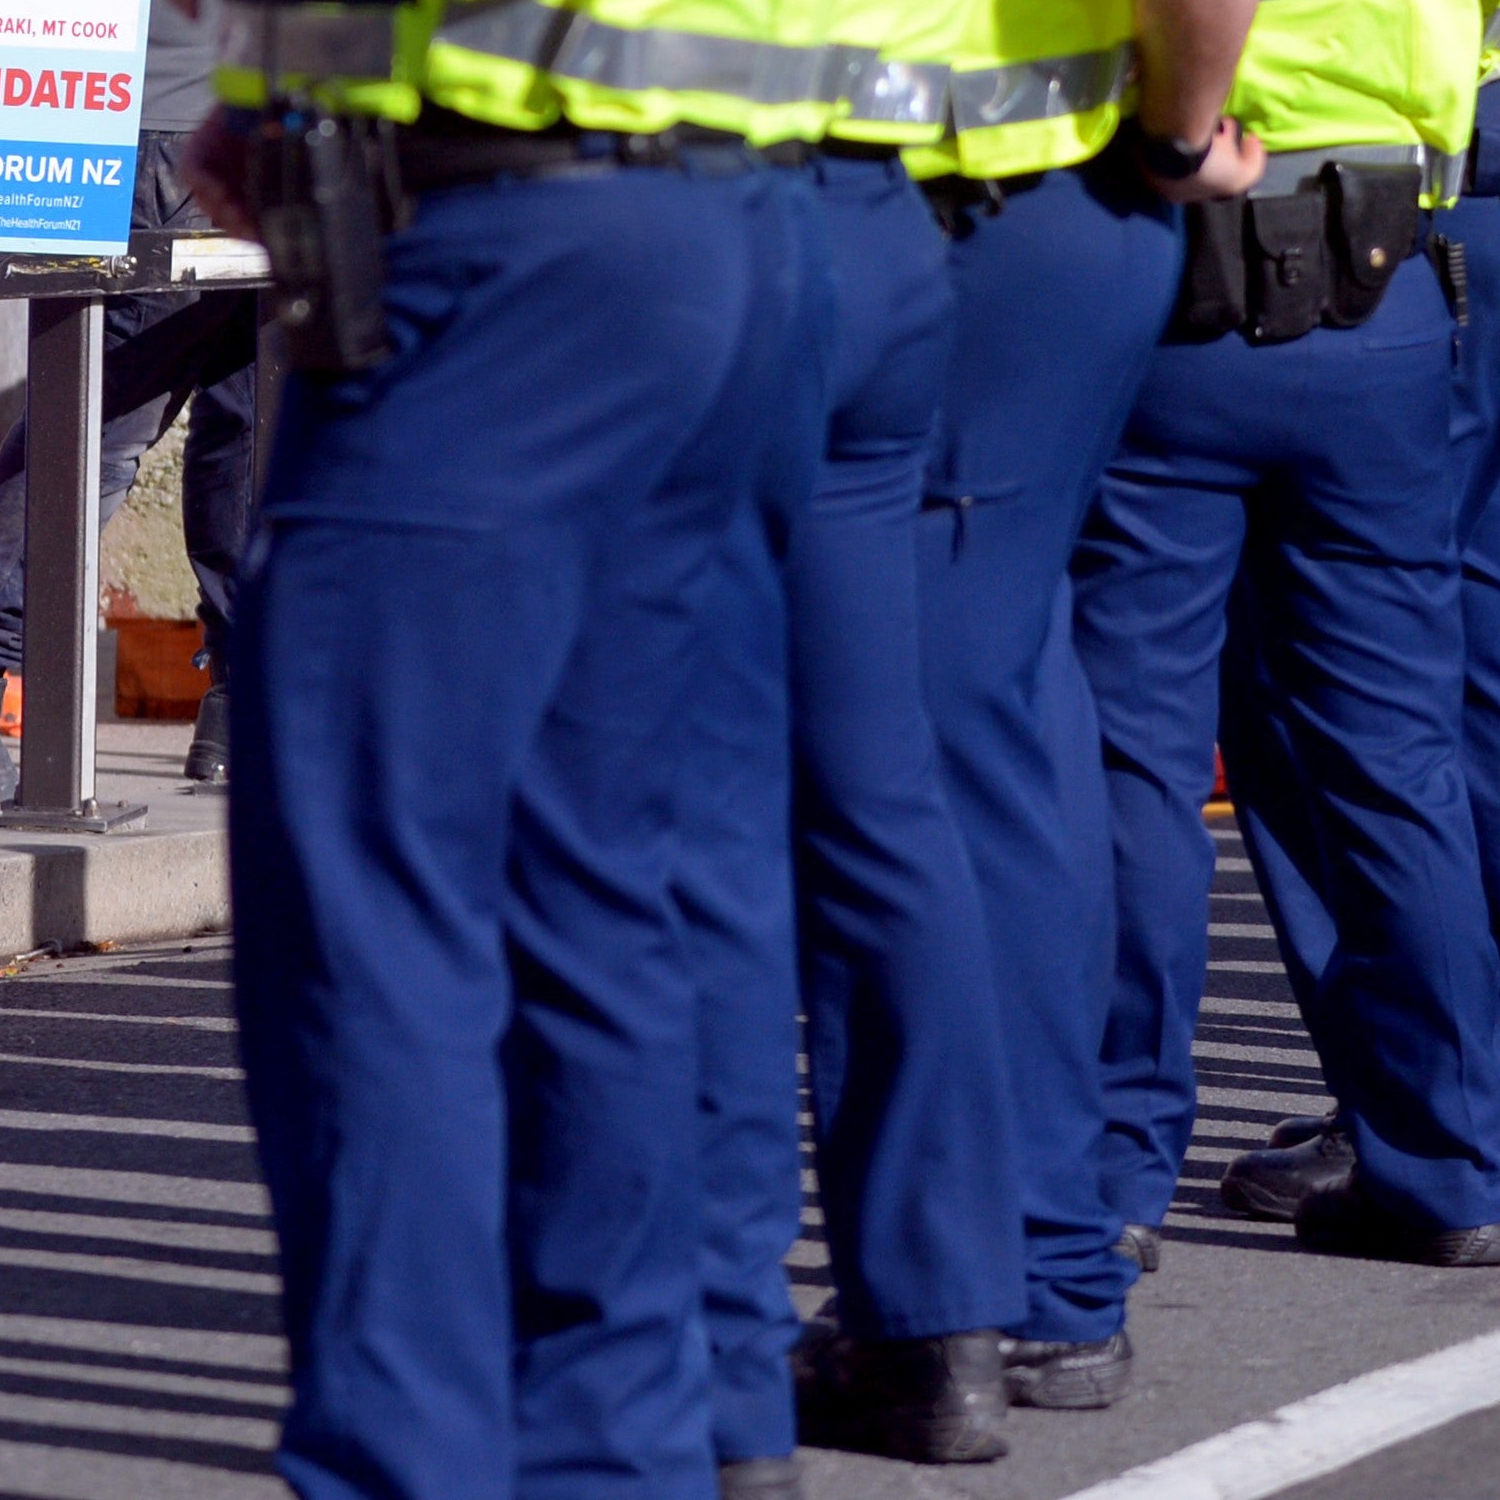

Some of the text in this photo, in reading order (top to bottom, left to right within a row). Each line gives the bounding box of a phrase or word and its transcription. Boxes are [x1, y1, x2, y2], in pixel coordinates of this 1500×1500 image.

[42, 19, 66, 37] MT
[71, 21, 118, 39] COOK
[81, 158, 122, 186] NZ
